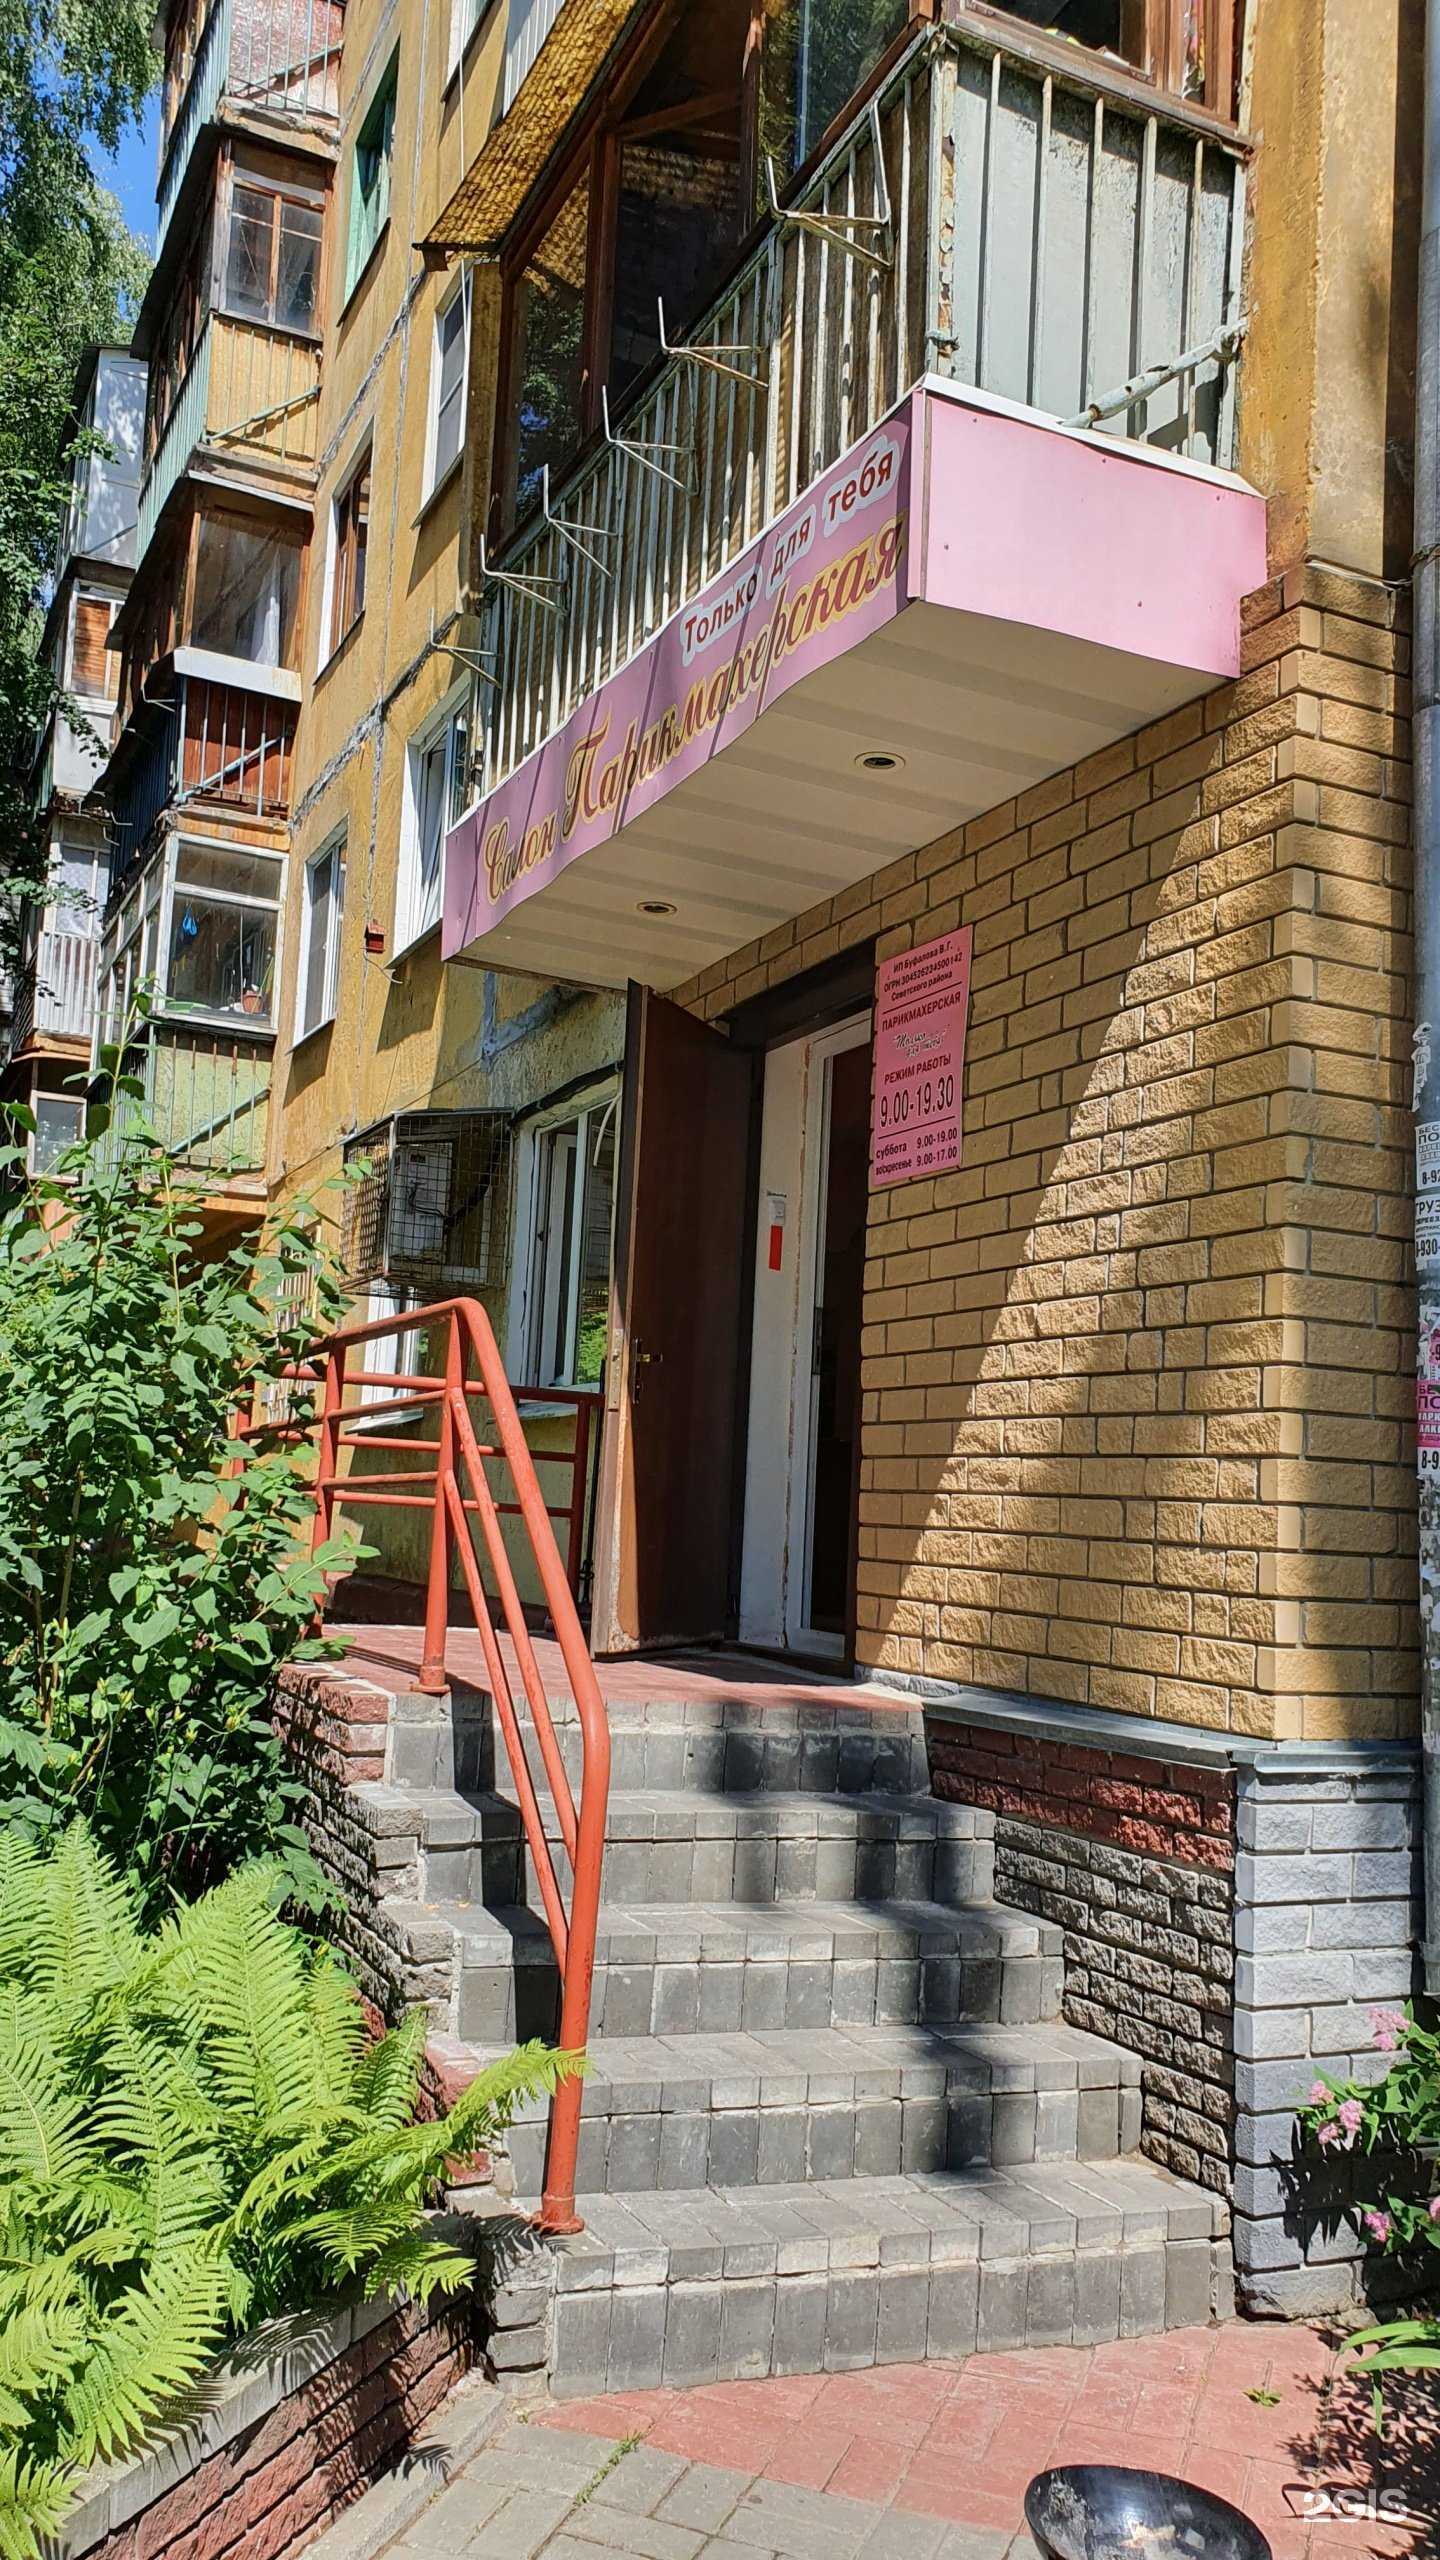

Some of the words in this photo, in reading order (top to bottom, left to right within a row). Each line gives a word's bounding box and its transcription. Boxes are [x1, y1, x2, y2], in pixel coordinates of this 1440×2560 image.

[684, 573, 758, 653] Только
[770, 515, 812, 586] для
[828, 450, 894, 521] тебя
[487, 817, 556, 901] Салон
[563, 518, 904, 839] Парикмахерская
[881, 990, 961, 1033] ПАРИКМАХЕРСКАЯ
[884, 1064, 915, 1085] РЕЖИМ
[916, 1053, 951, 1075] РАБОТЫ
[880, 1074, 954, 1127] 9.00-19.30
[875, 1142, 907, 1161] суббота
[916, 1127, 958, 1149] 9.00-19.00
[916, 1145, 958, 1167] 9.00-17.00
